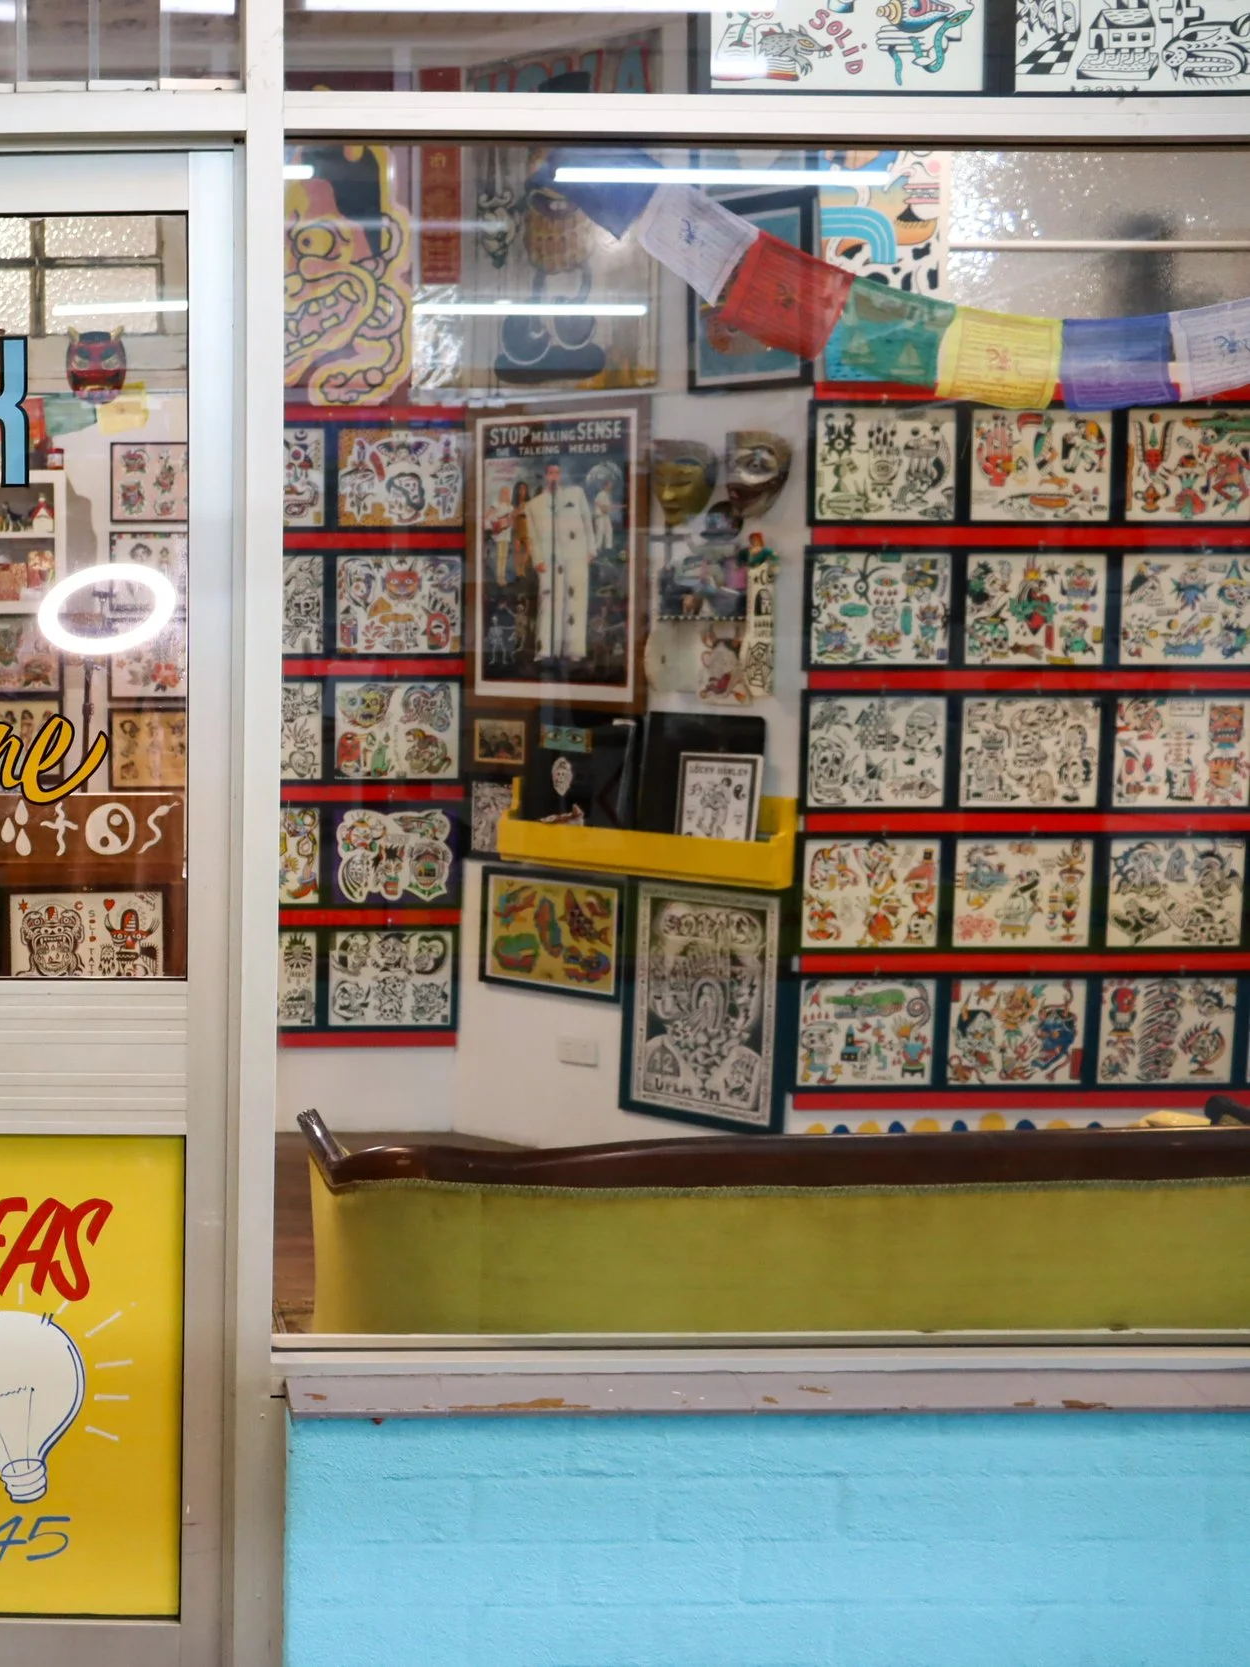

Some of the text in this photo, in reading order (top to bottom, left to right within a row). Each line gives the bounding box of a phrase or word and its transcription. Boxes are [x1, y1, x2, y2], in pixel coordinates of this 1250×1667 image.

[489, 420, 622, 446] STOP MAKING SENSE
[518, 445, 560, 456] TALKING
[568, 443, 607, 454] HEADS
